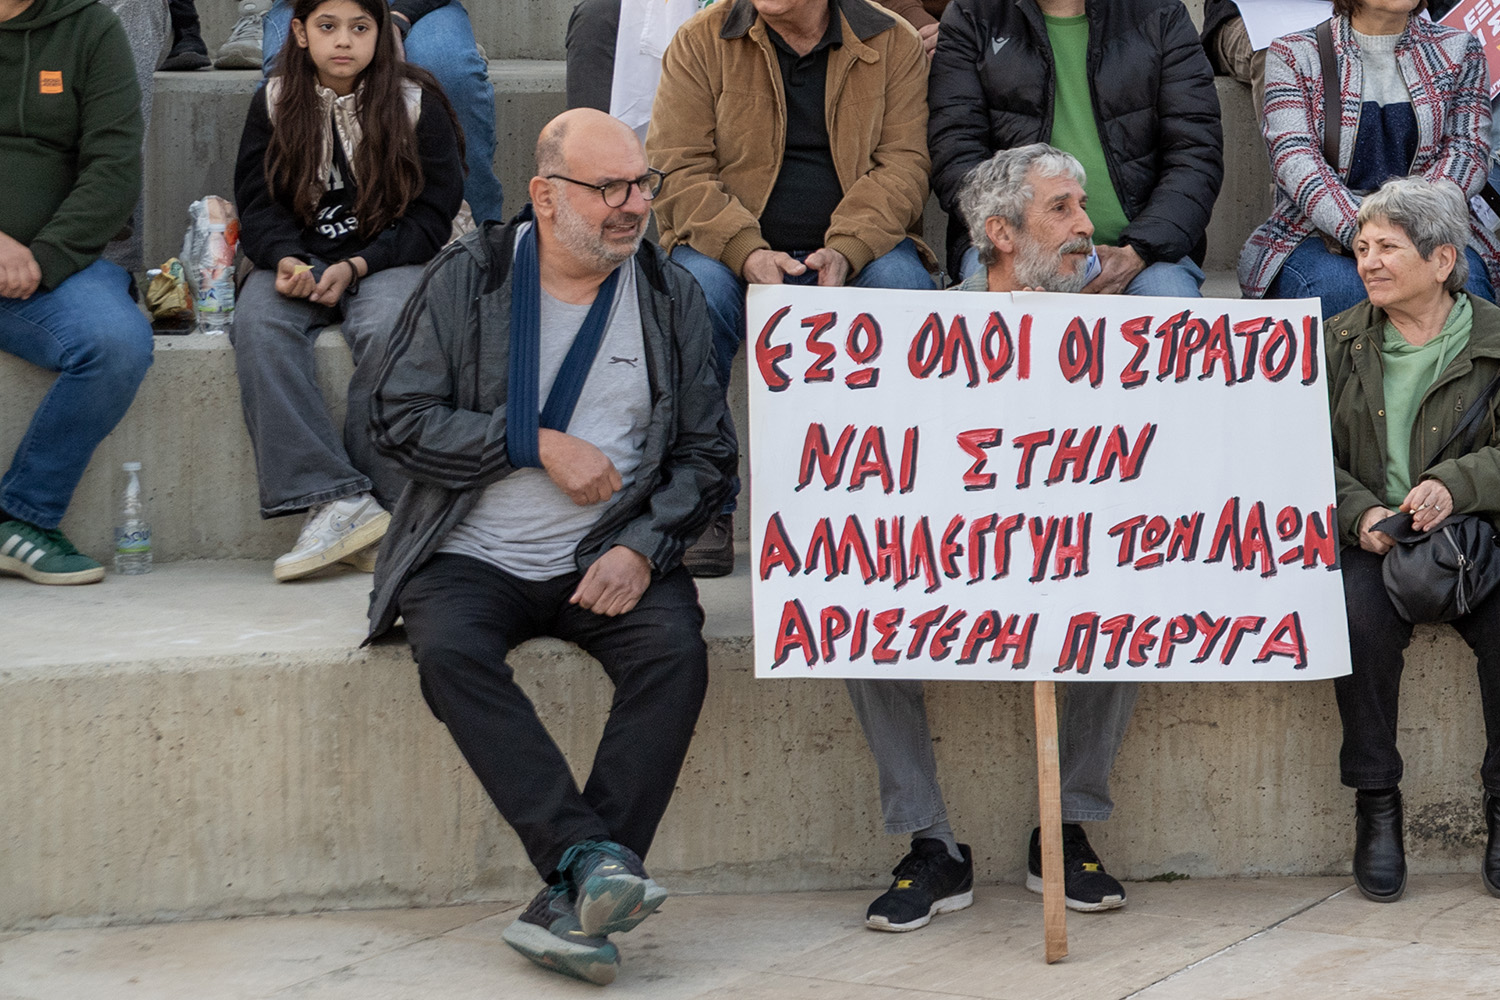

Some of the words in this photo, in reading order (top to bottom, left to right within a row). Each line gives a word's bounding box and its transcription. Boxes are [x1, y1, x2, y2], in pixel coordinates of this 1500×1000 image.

[755, 305, 882, 391] ΕΞΩ
[908, 311, 1034, 388] ΟΛΟΙ
[1058, 316, 1105, 388] ΟΙ
[1119, 309, 1318, 389] ΣΤΡΑΤΟΙ
[795, 422, 919, 494] ΝΑΙ
[956, 423, 1157, 491] ΣΤΗΝ
[760, 511, 1091, 594] ΑΛΛΗΛΕΓΓΥΗ
[1107, 511, 1204, 571] ΤΩΝ
[1204, 496, 1341, 578] ΛΑΩΝ
[771, 598, 1039, 670] ΑΡΙΣΤΕΡΗ
[1053, 610, 1308, 674] ΠΤΕΡΥΓΑ
